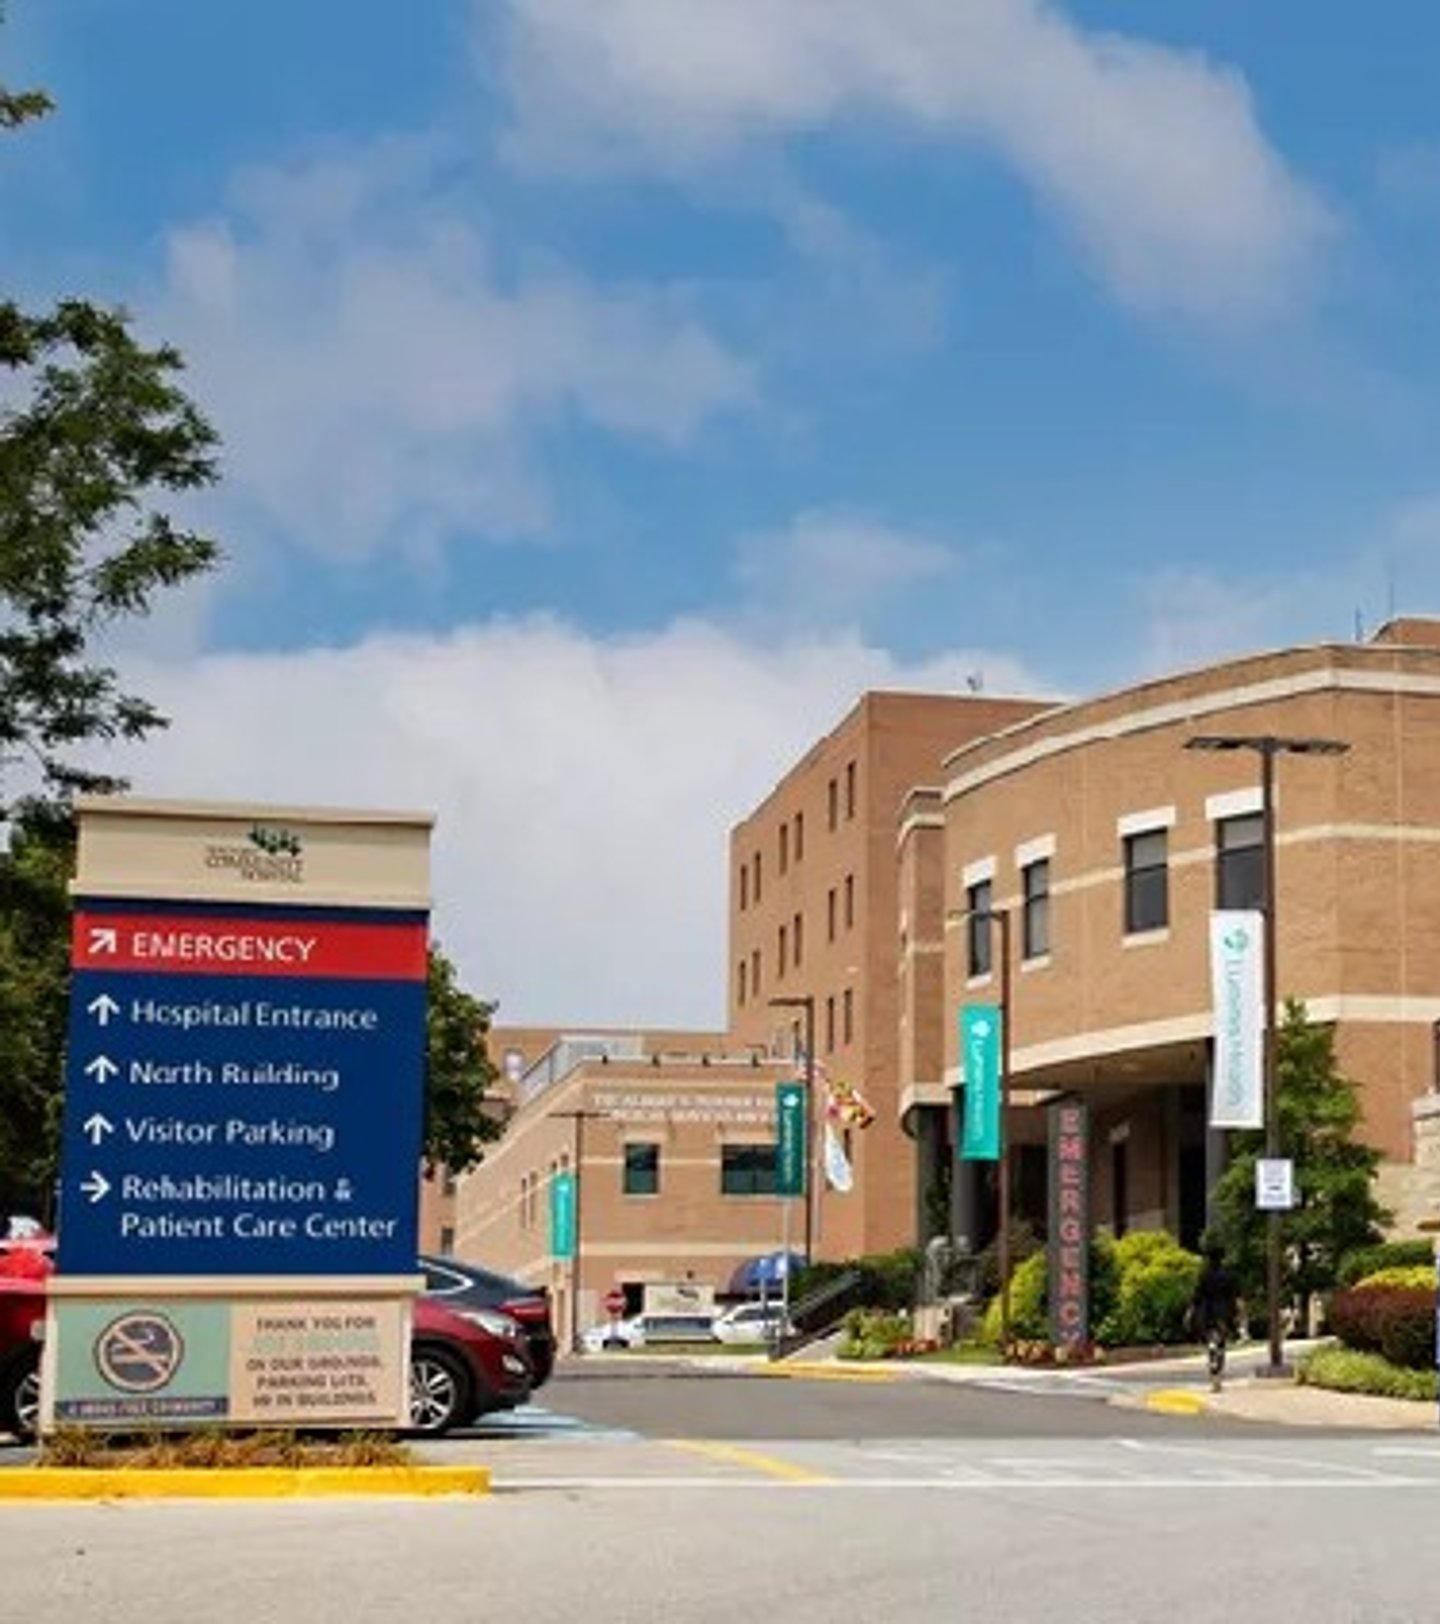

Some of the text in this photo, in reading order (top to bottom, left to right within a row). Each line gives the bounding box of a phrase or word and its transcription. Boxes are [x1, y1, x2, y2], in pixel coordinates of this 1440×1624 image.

[132, 933, 316, 961] EMERGENCY
[132, 1000, 378, 1030] Hospital Entrance
[130, 1061, 340, 1091] North Building
[125, 1119, 335, 1151] Visitor Parking
[122, 1175, 354, 1201] Rehabilitation &
[121, 1213, 396, 1238] Patient Care Center
